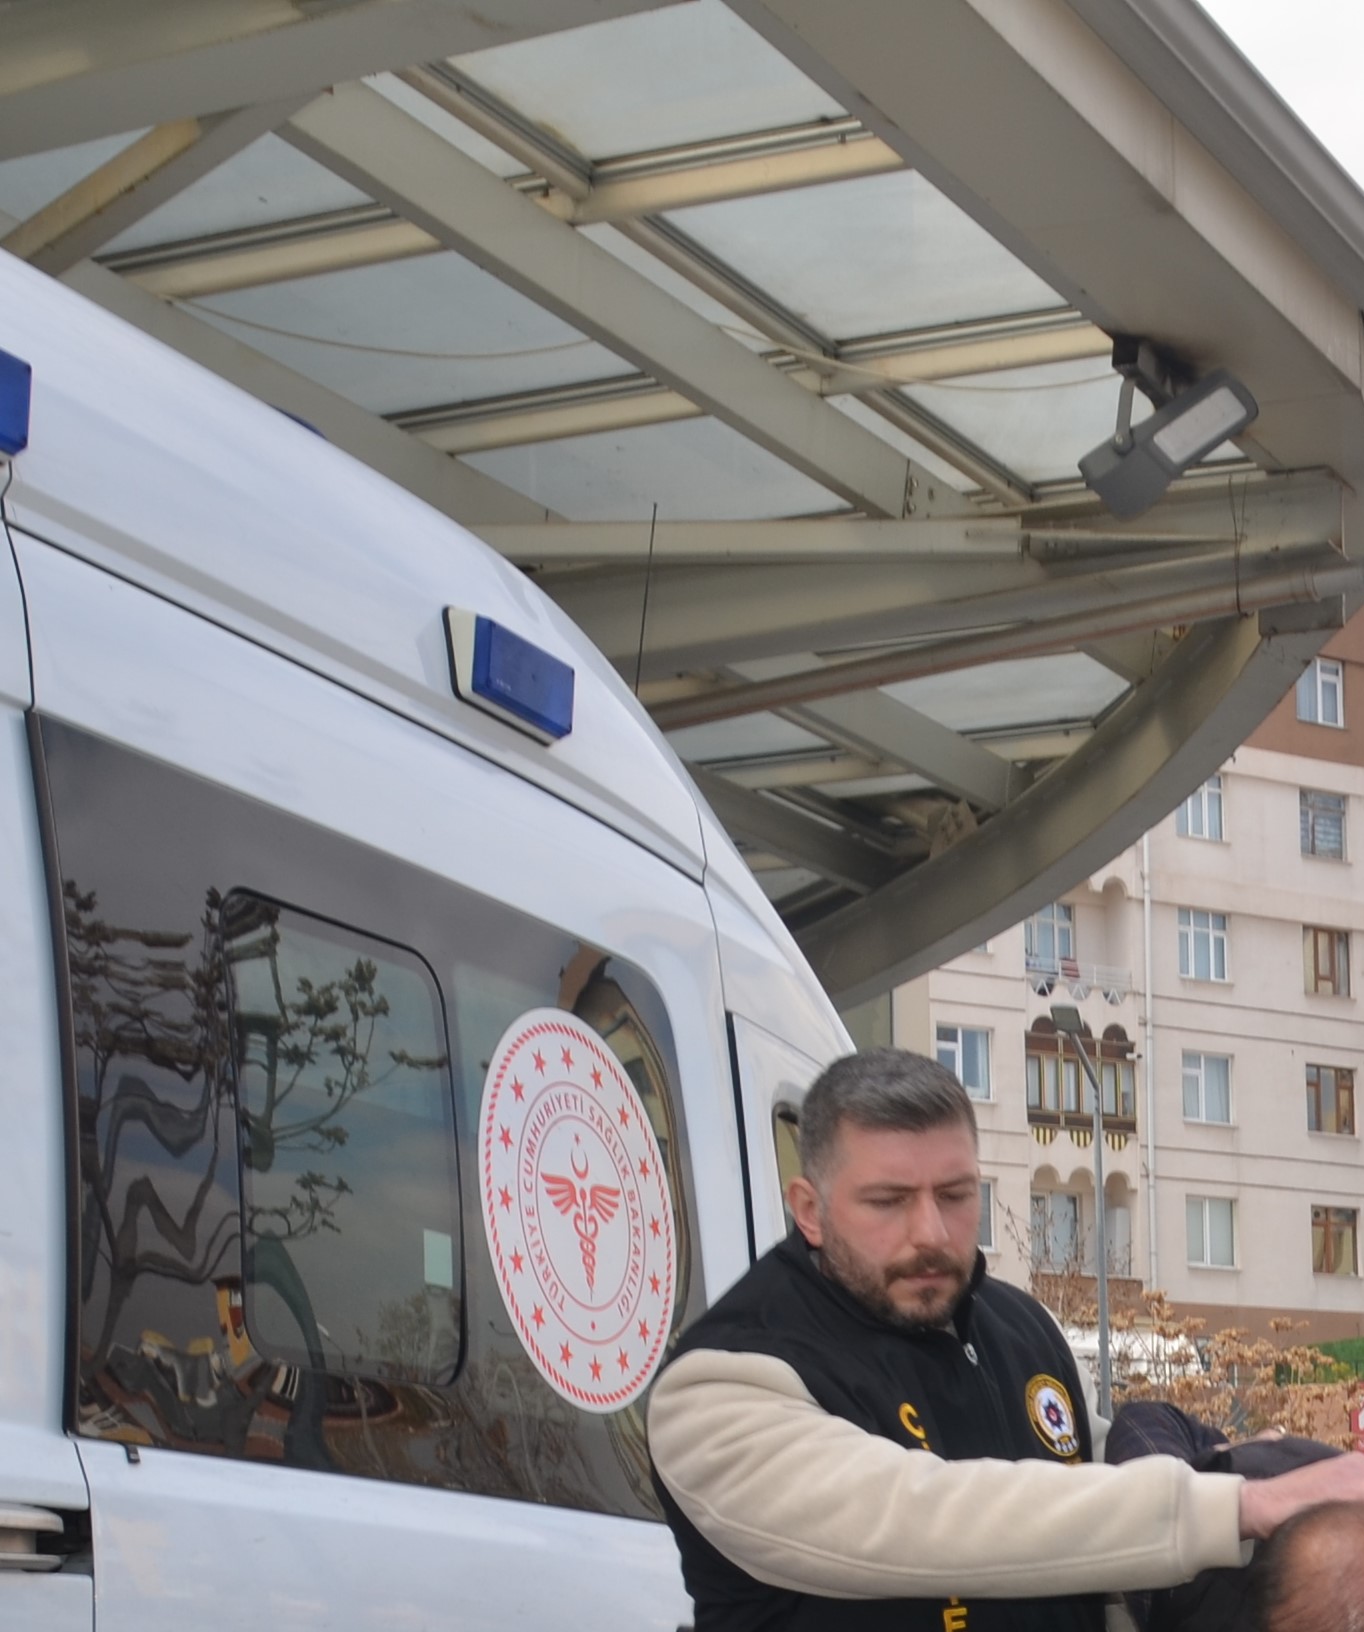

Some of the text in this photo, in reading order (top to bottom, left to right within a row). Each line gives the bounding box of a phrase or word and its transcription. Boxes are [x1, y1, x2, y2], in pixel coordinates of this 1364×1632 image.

[523, 1091, 641, 1319] TÜRKİYE CUMHURİYETİ SAĞLIK BAKANLIĞI
